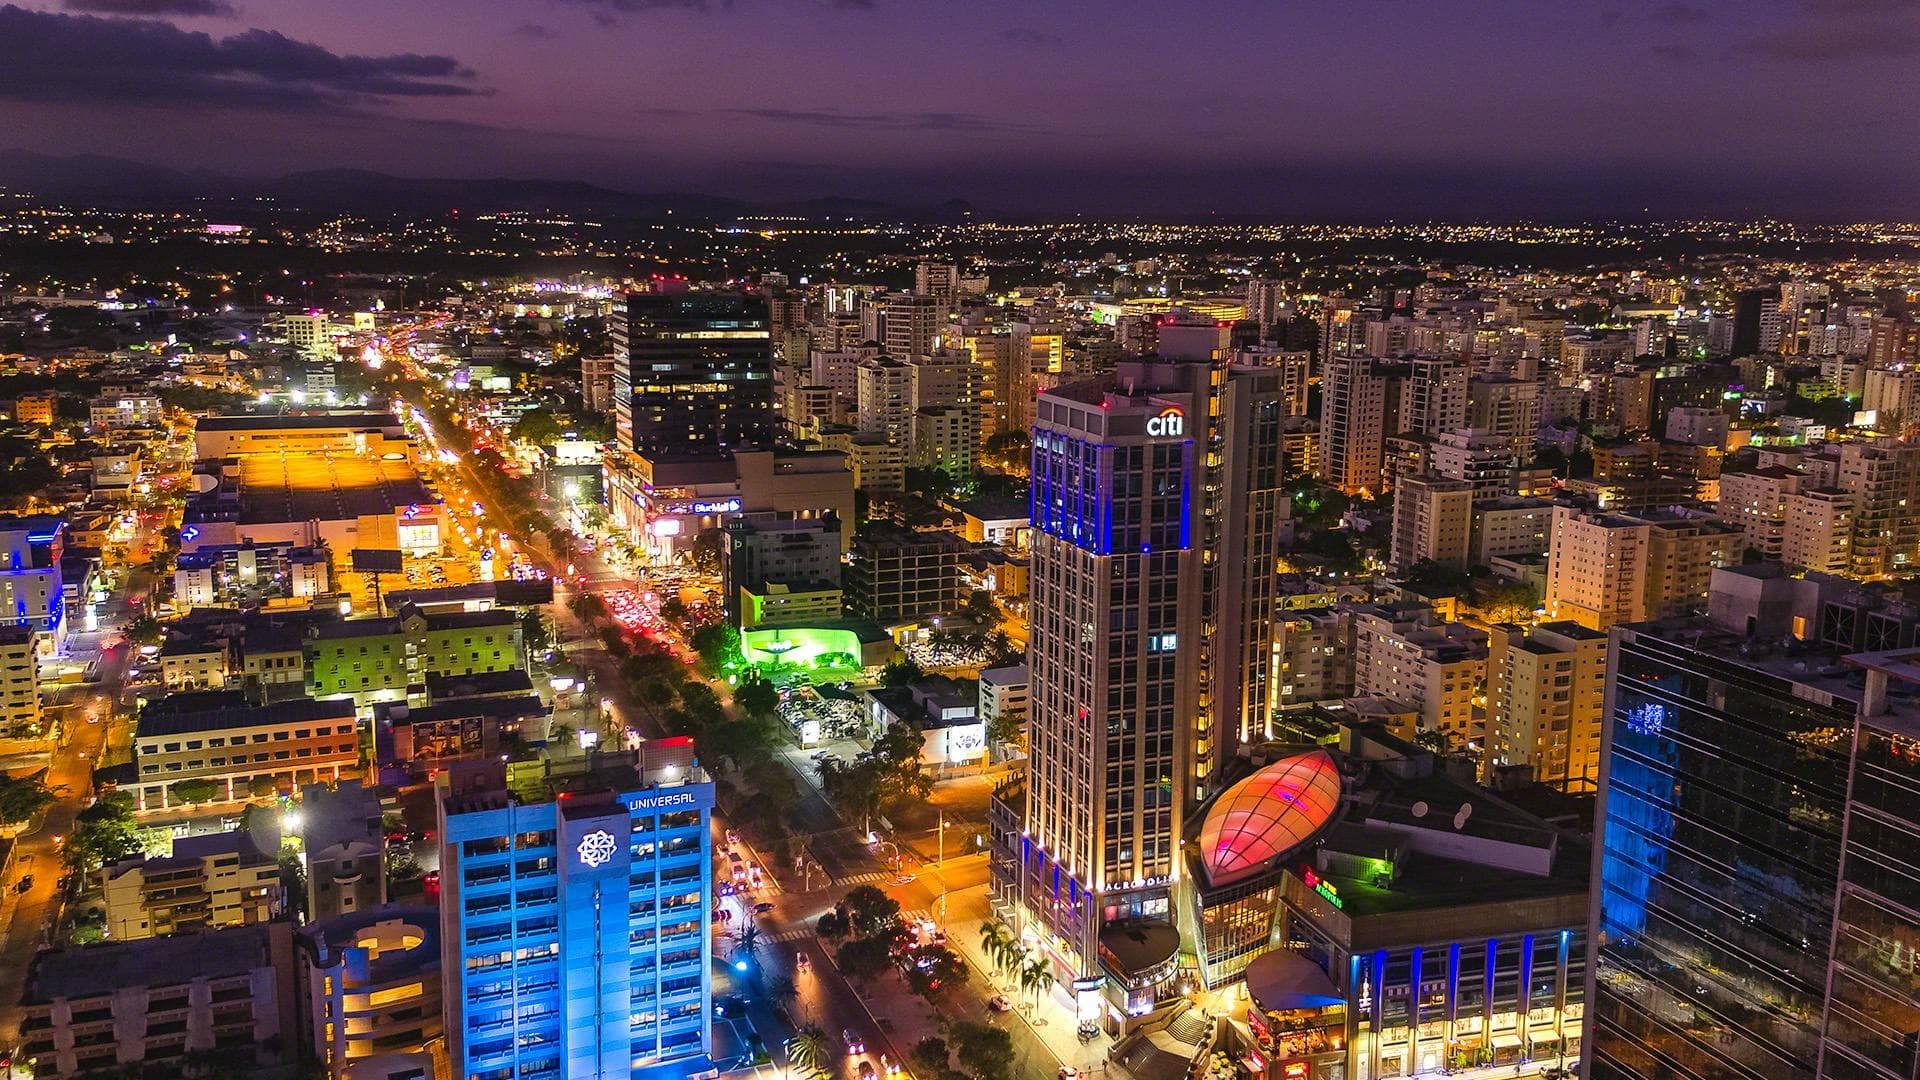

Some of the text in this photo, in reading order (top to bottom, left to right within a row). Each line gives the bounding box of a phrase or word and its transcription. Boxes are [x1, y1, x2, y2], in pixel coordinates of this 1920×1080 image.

[1146, 413, 1183, 437] citi
[629, 793, 696, 810] UNIVERSAL
[1105, 875, 1175, 891] ACROPOLIS
